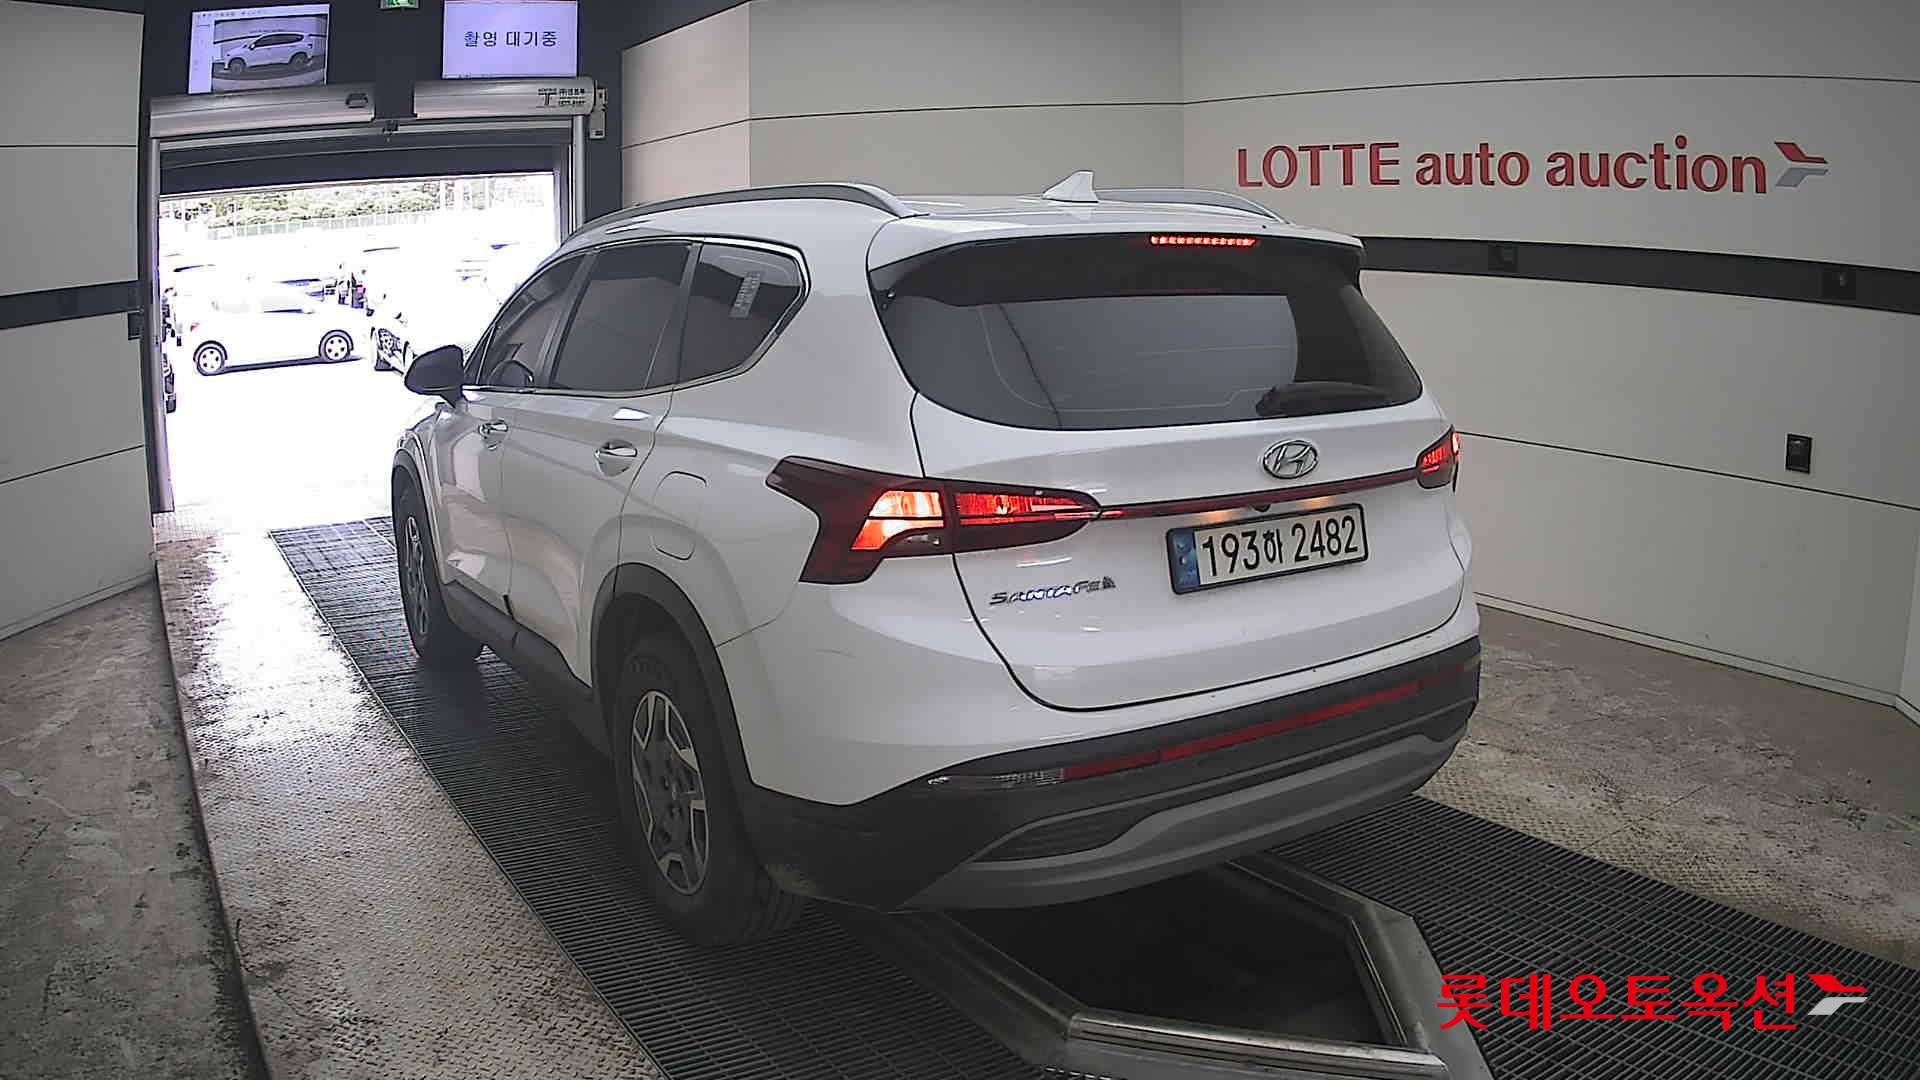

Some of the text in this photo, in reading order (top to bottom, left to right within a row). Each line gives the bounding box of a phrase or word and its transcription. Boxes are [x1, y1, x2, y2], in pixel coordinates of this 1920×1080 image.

[464, 30, 558, 48] 촬영 대기중
[1238, 135, 1767, 194] LOTTE auto auction
[1202, 515, 1359, 577] 193하 2482
